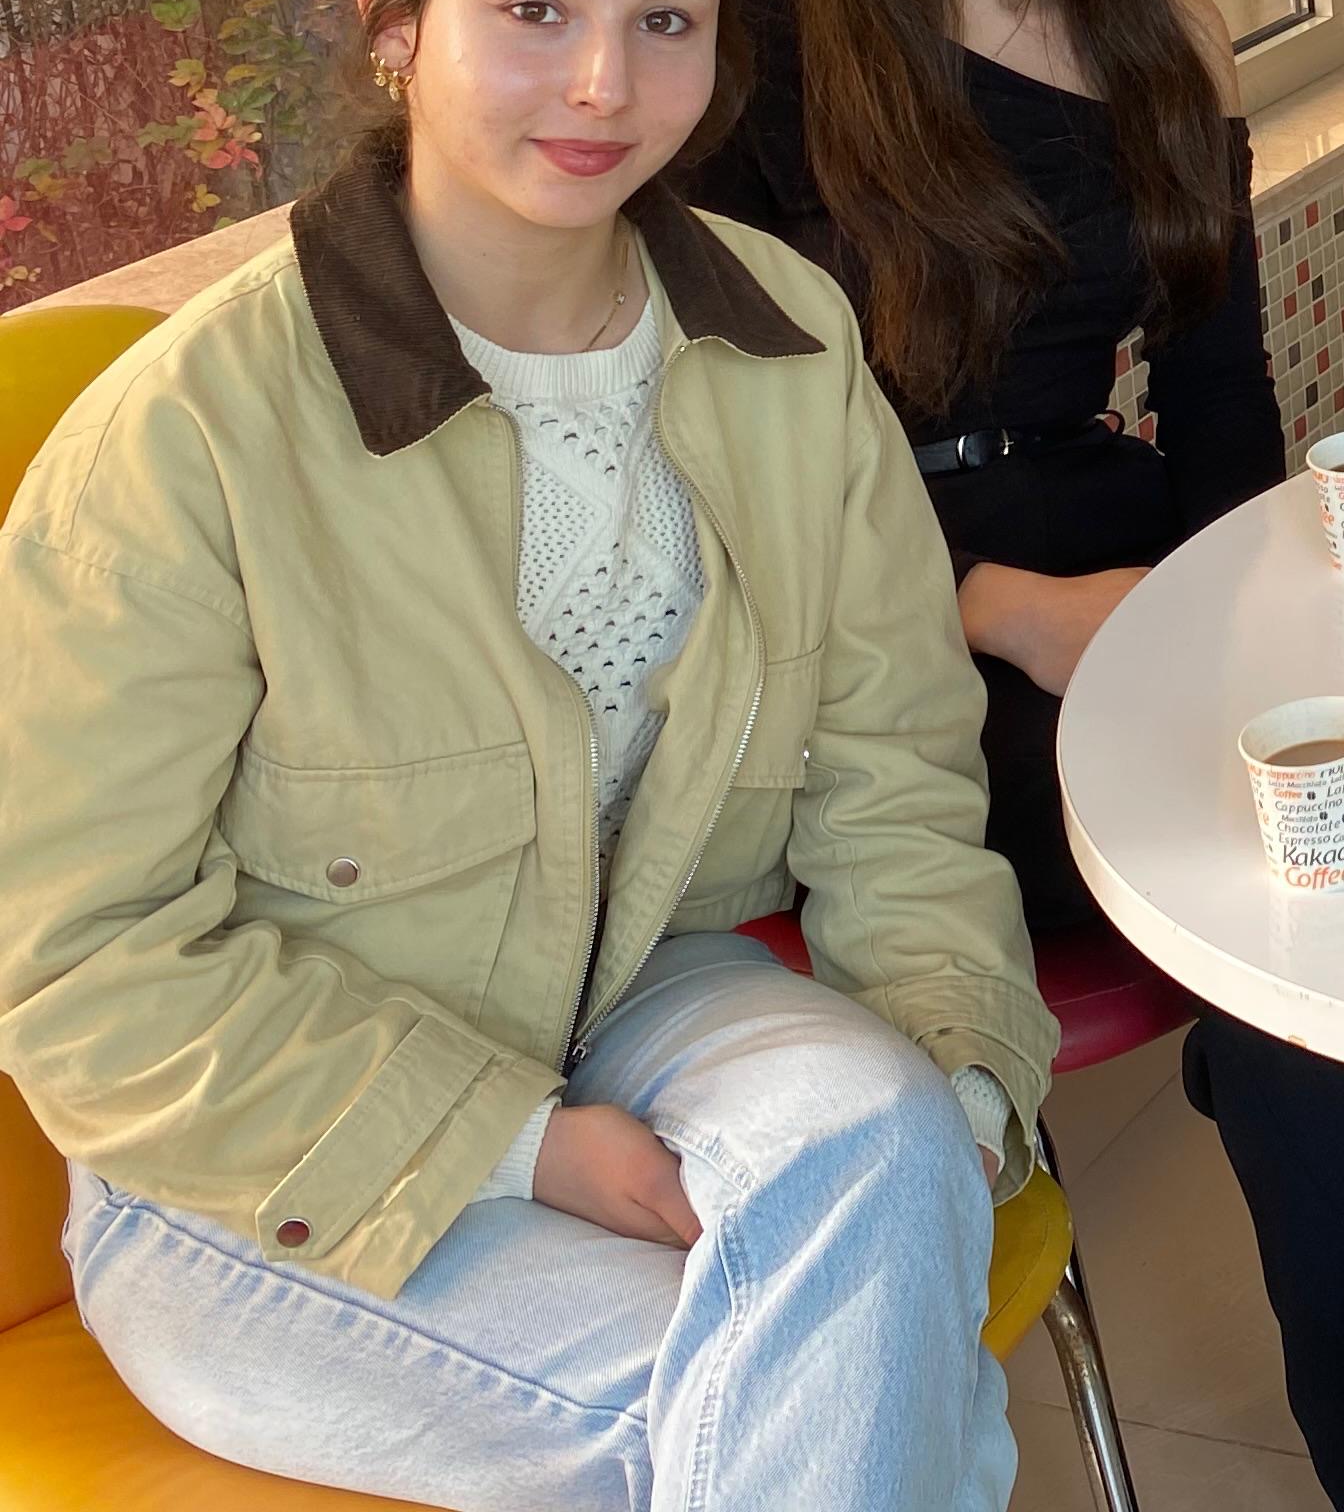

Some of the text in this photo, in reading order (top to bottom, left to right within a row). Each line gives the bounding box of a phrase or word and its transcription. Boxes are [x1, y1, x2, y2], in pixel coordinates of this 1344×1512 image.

[1275, 798, 1343, 815] Cappuccino
[1277, 819, 1341, 834] Chocolate
[1278, 834, 1331, 847] Espresso
